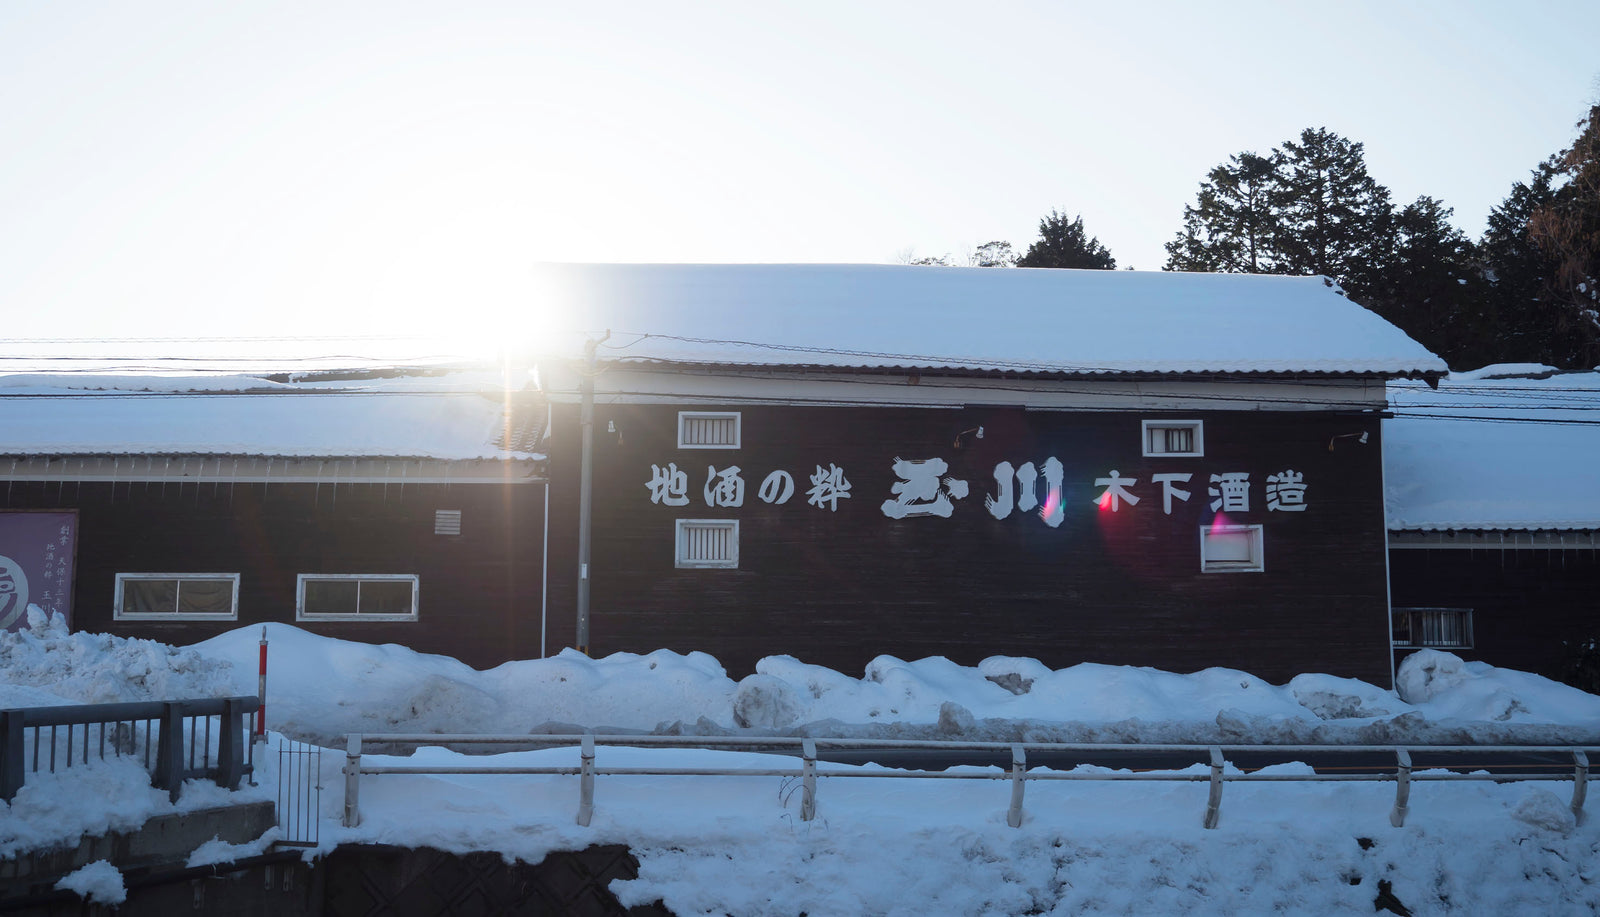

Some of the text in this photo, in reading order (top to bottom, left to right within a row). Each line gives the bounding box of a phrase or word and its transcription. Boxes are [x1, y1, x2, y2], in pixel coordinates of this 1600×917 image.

[644, 456, 1308, 528] 地酒の粋 玉川 木下酒造
